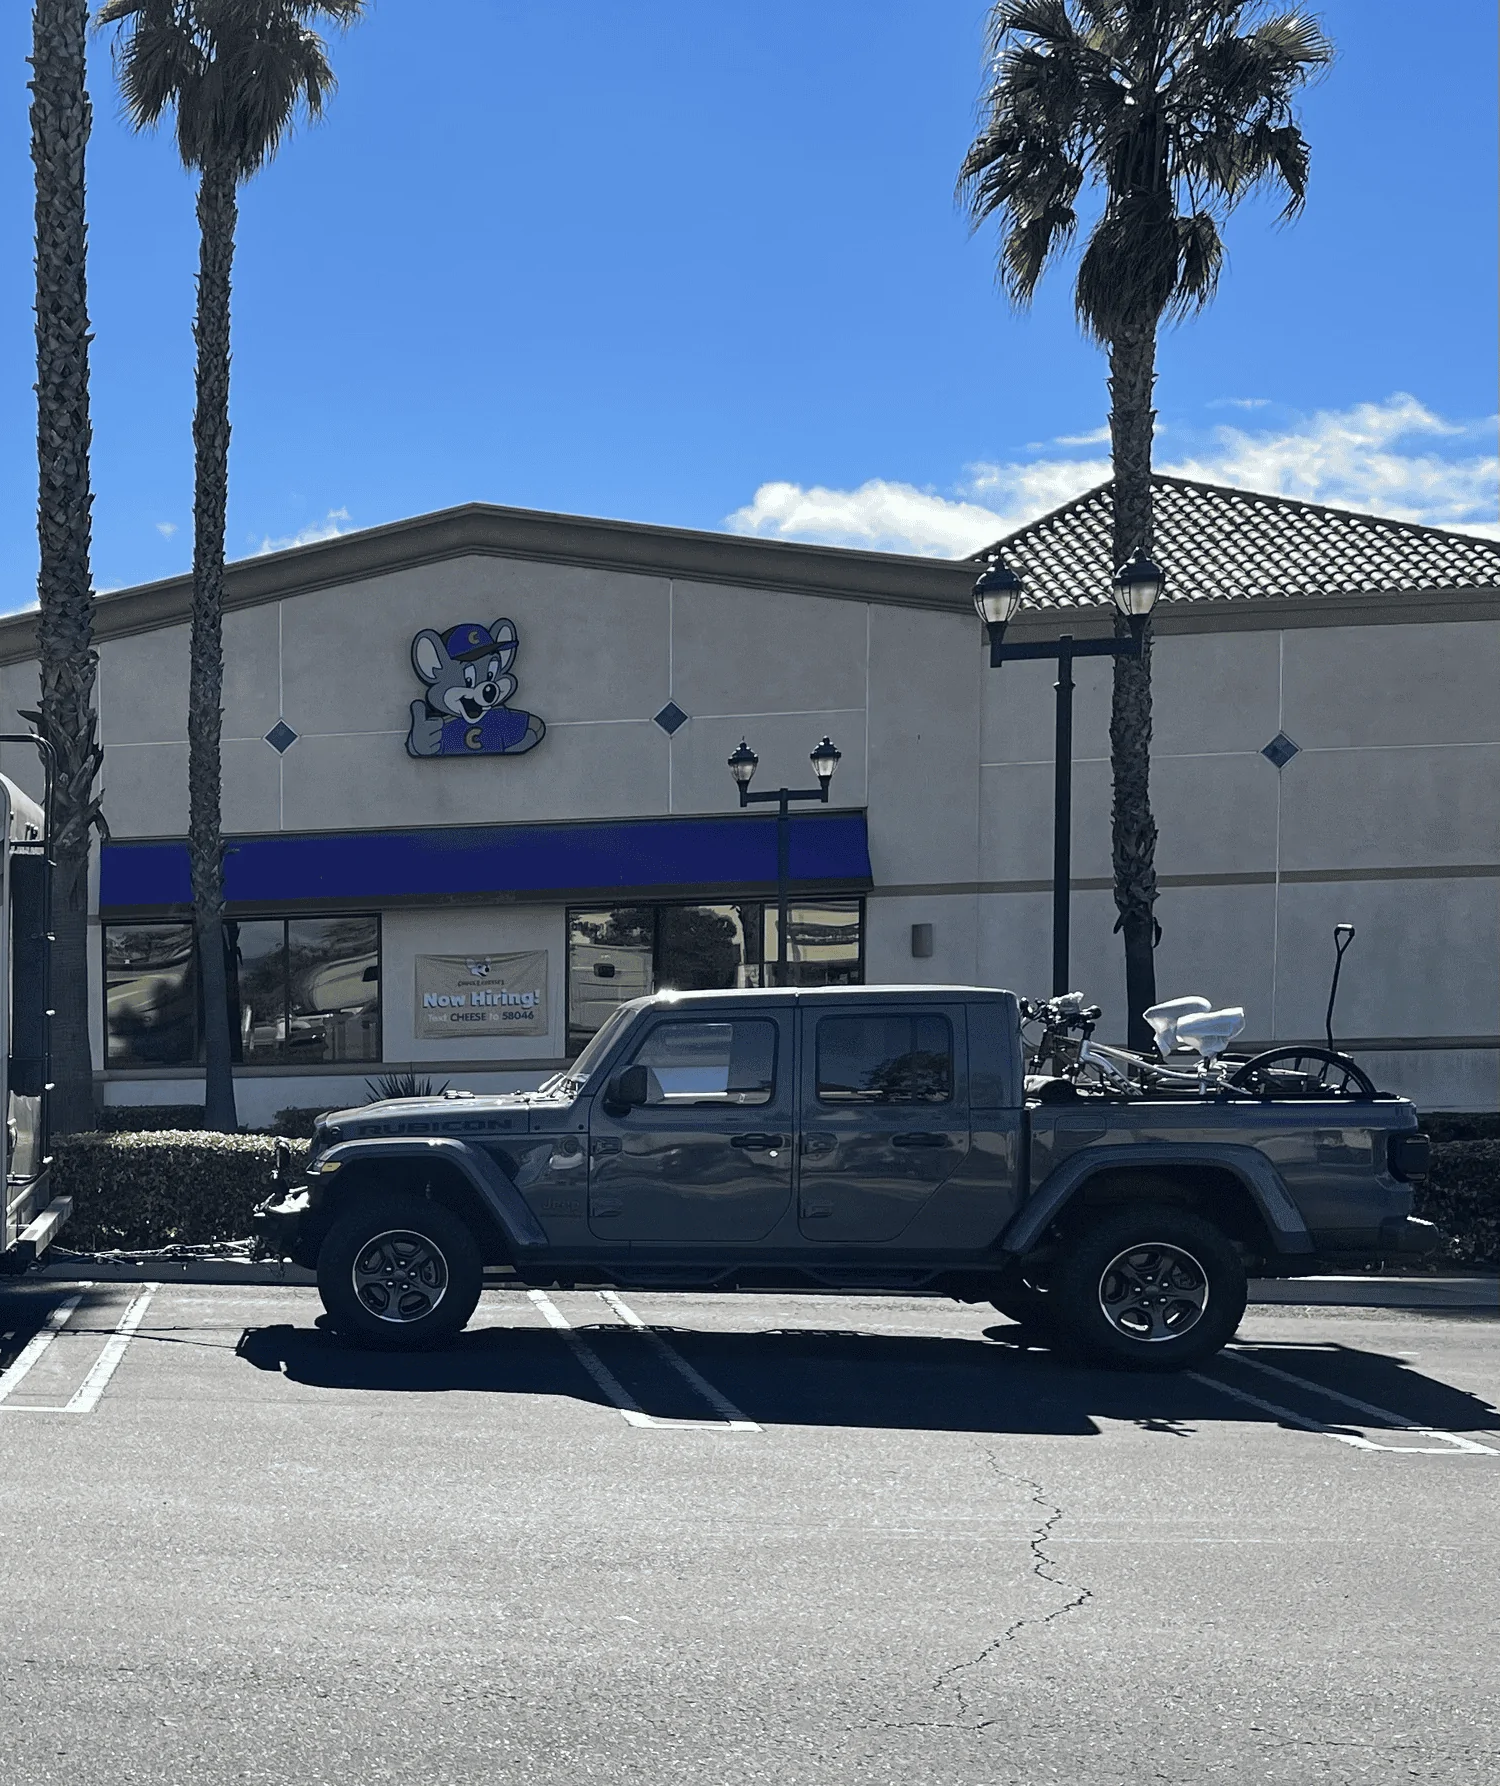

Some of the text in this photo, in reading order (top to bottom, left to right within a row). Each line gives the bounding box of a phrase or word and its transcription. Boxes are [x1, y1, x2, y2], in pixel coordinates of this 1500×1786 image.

[468, 631, 479, 645] C
[464, 727, 483, 750] C
[422, 988, 541, 1010] Now Hiring!
[428, 1011, 535, 1022] Text CHEESE to 58046
[357, 1118, 513, 1136] RUBICON
